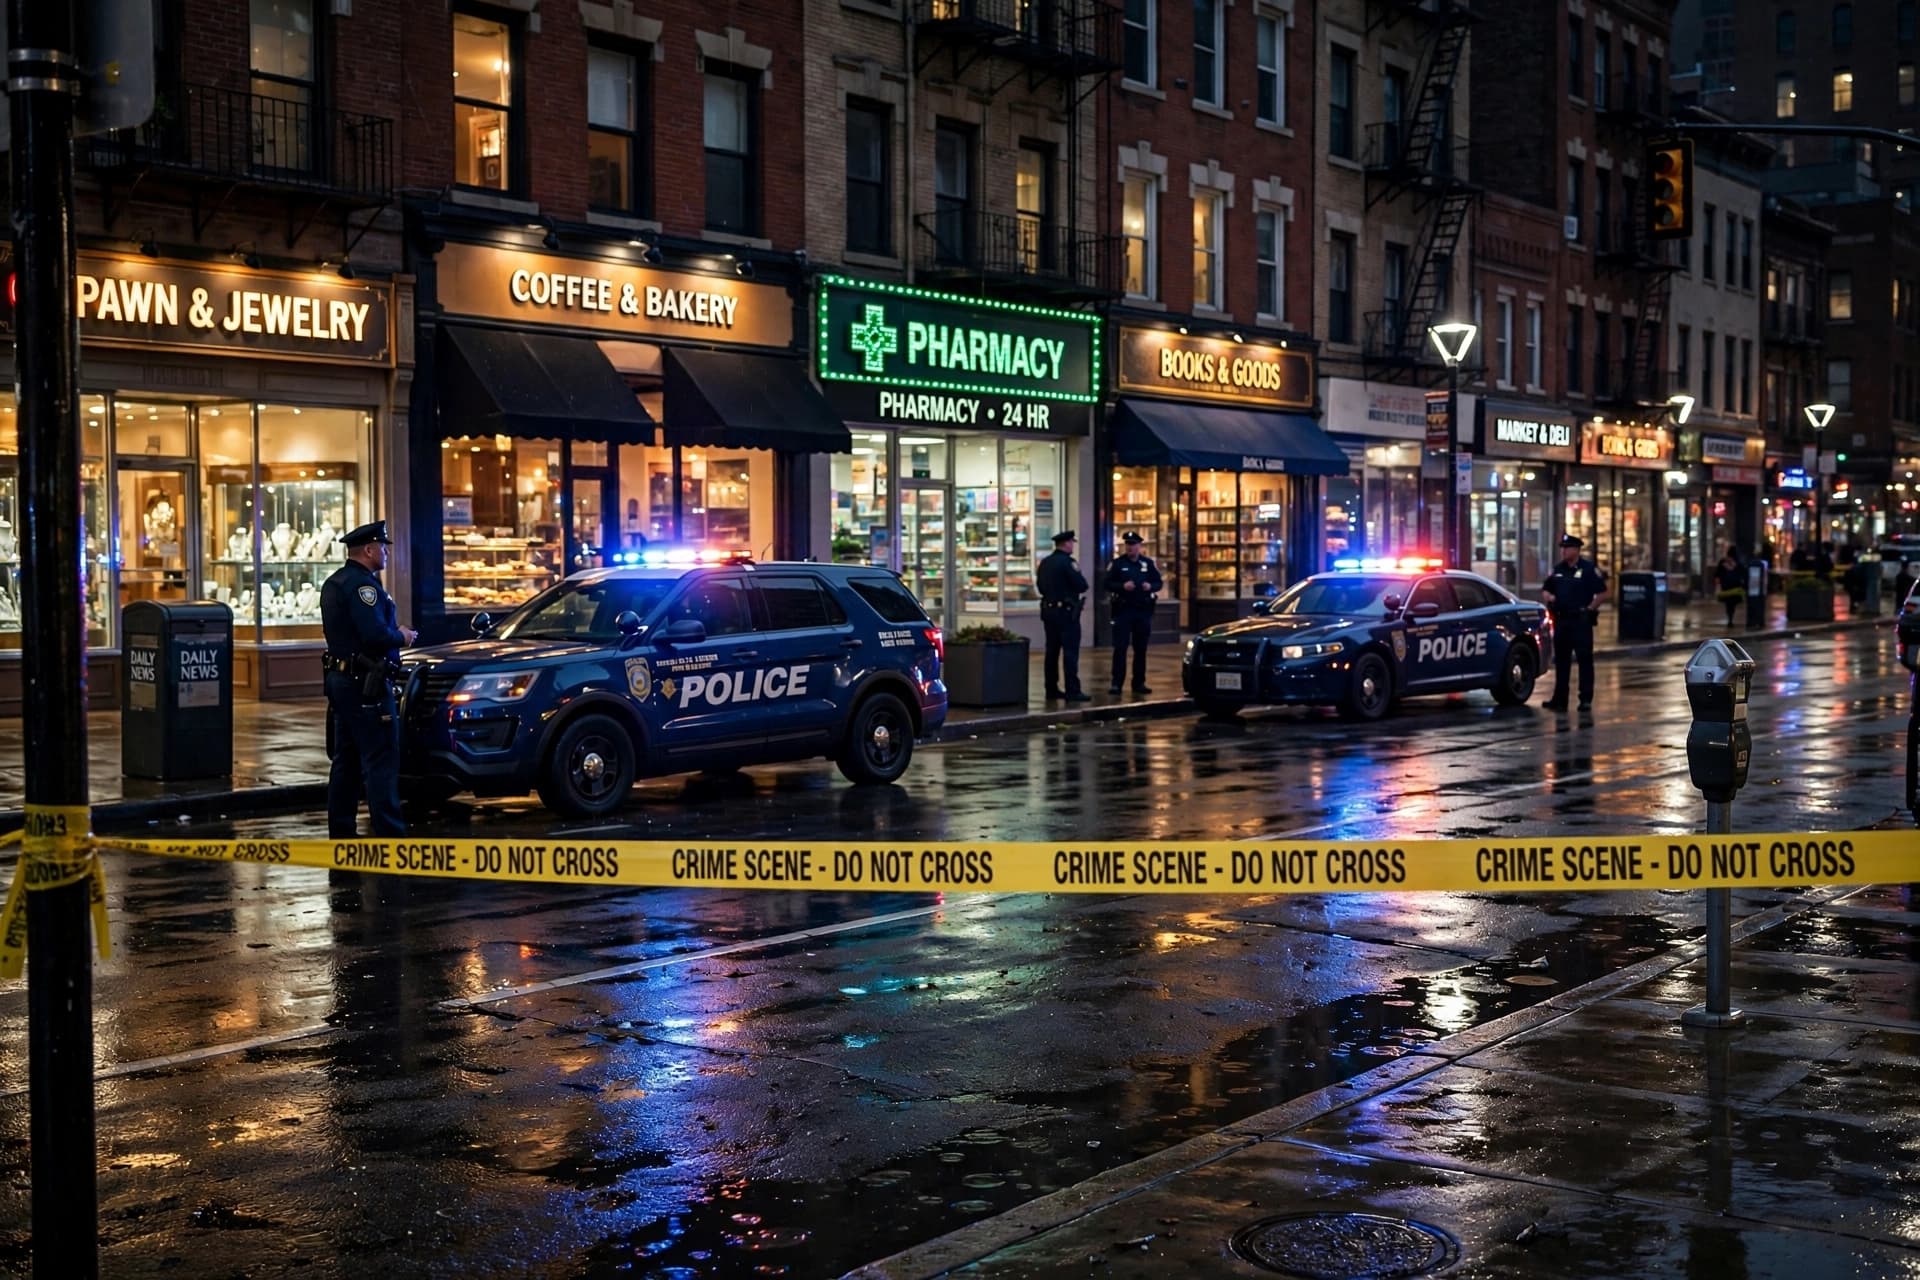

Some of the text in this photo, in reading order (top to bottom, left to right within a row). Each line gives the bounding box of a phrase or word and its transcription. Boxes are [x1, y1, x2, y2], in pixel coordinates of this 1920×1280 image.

[77, 275, 370, 342] PAWN & JEWELRY
[511, 269, 739, 326] COFFEE & BAKERY
[907, 321, 1065, 381] PHARMACY
[1161, 348, 1281, 391] BOOKS & GOODS
[879, 391, 980, 424] PHARMACY
[1002, 402, 1023, 428] 24
[1027, 404, 1049, 430] HR
[1497, 418, 1570, 447] MARKET & DELI
[130, 650, 156, 666] DAILY
[180, 649, 218, 665] DAILY
[1417, 632, 1488, 663] POLICE
[130, 665, 155, 681] NEWS
[180, 664, 219, 680] NEWS
[679, 664, 811, 709] POLICE
[233, 842, 290, 863] CROSS
[333, 843, 390, 869] CRIME
[396, 844, 456, 872] SCENE
[475, 845, 501, 873] DO
[508, 846, 547, 875] NOT
[553, 847, 619, 878] CROSS
[672, 849, 738, 881] CRIME
[744, 850, 812, 882] SCENE
[834, 851, 863, 883] DO
[871, 851, 914, 883] NOT
[920, 852, 992, 884] CROSS
[1054, 851, 1125, 884] CRIME
[1133, 851, 1208, 884] SCENE
[1231, 851, 1264, 884] DO
[1271, 850, 1318, 884] NOT
[1325, 849, 1406, 884] CROSS
[1476, 848, 1555, 883] CRIME
[1562, 846, 1643, 882] SCENE
[1668, 844, 1702, 880] DO
[1712, 843, 1762, 878] NOT
[1769, 840, 1856, 878] CROSS
